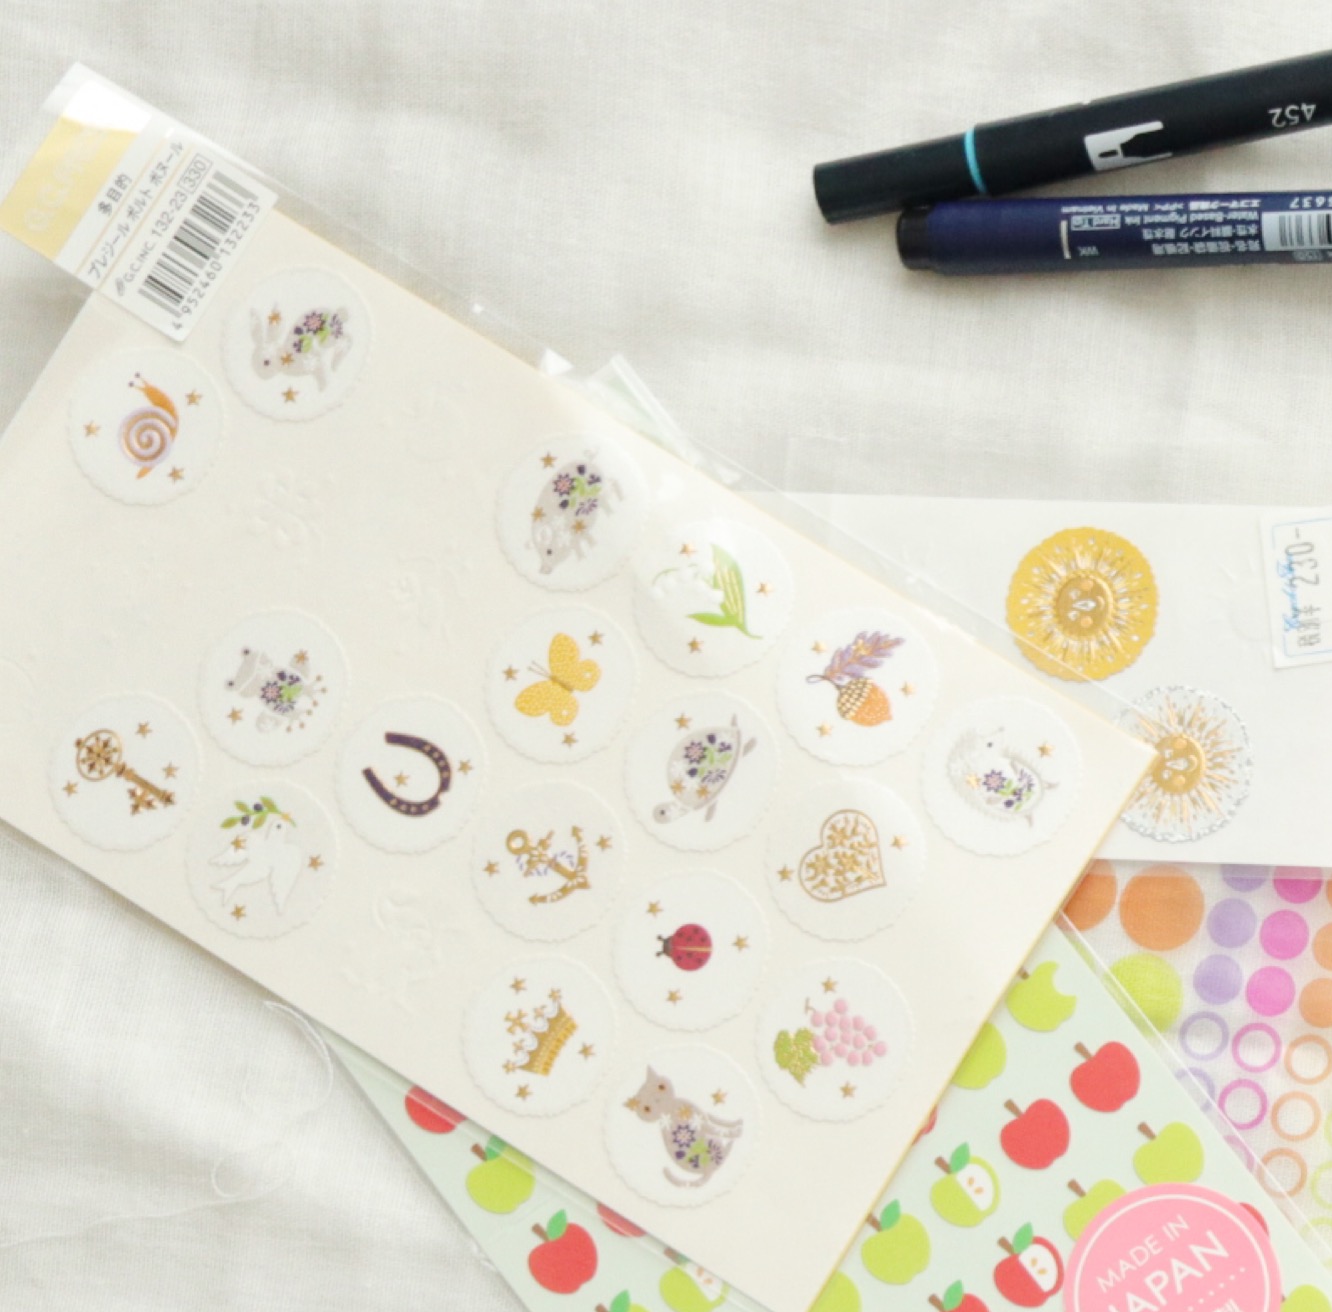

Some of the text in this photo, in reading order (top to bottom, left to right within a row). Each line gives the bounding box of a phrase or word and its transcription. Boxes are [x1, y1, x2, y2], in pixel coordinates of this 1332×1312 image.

[1266, 98, 1317, 127] 452
[98, 173, 130, 215] 多目的
[151, 193, 188, 238] 132-23
[183, 161, 207, 189] 330
[1061, 205, 1103, 213] Vietnam
[1119, 203, 1148, 211] Made
[1124, 215, 1139, 224] Ink
[1143, 211, 1187, 224] Pigment
[1190, 210, 1258, 222] Water-Based
[1095, 1212, 1190, 1293] MADE IN
